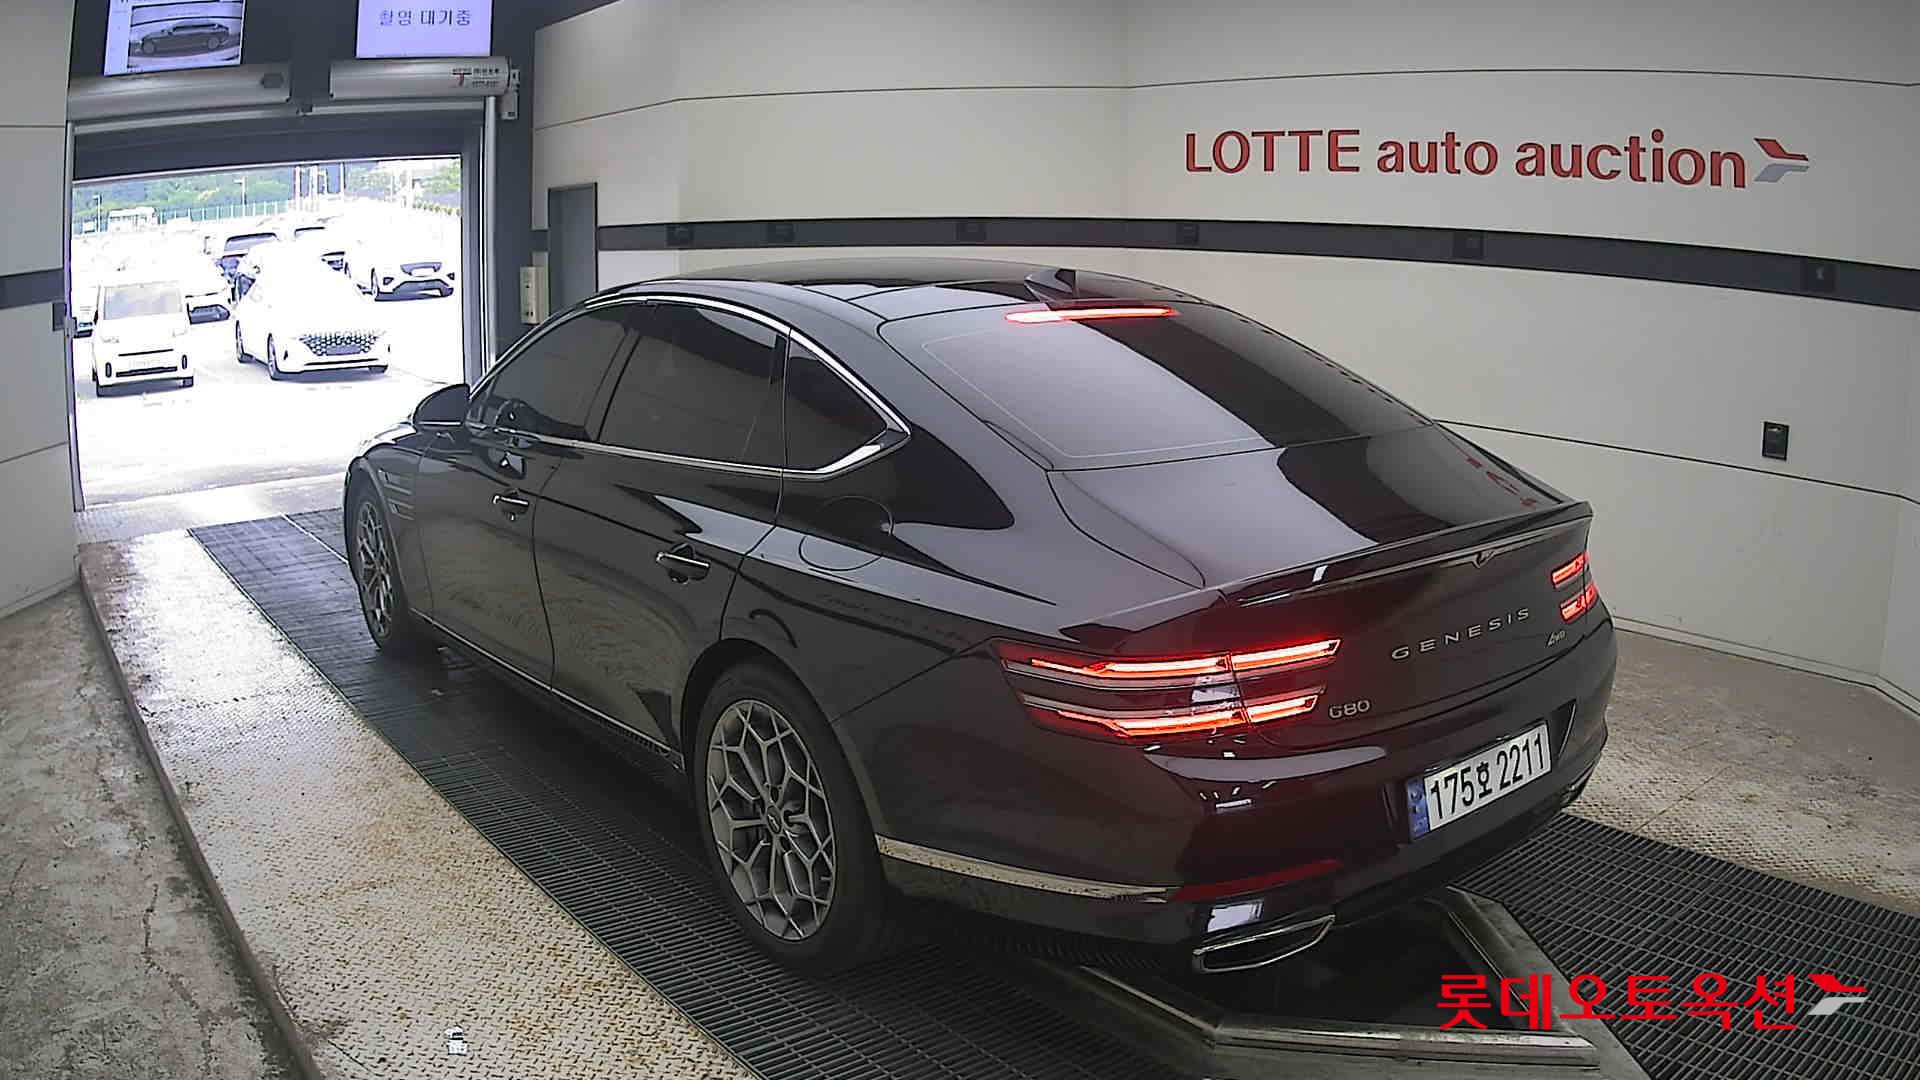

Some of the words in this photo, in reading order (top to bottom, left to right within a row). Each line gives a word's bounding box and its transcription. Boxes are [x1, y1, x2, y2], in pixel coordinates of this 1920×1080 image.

[420, 9, 471, 26] 대기중
[1185, 129, 1360, 174] LOTTE
[1377, 131, 1498, 175] auto
[1516, 129, 1746, 188] auction
[1391, 608, 1530, 660] GENESIS
[1329, 700, 1370, 719] G80
[1431, 761, 1493, 819] 175호
[1496, 733, 1544, 791] 2211
